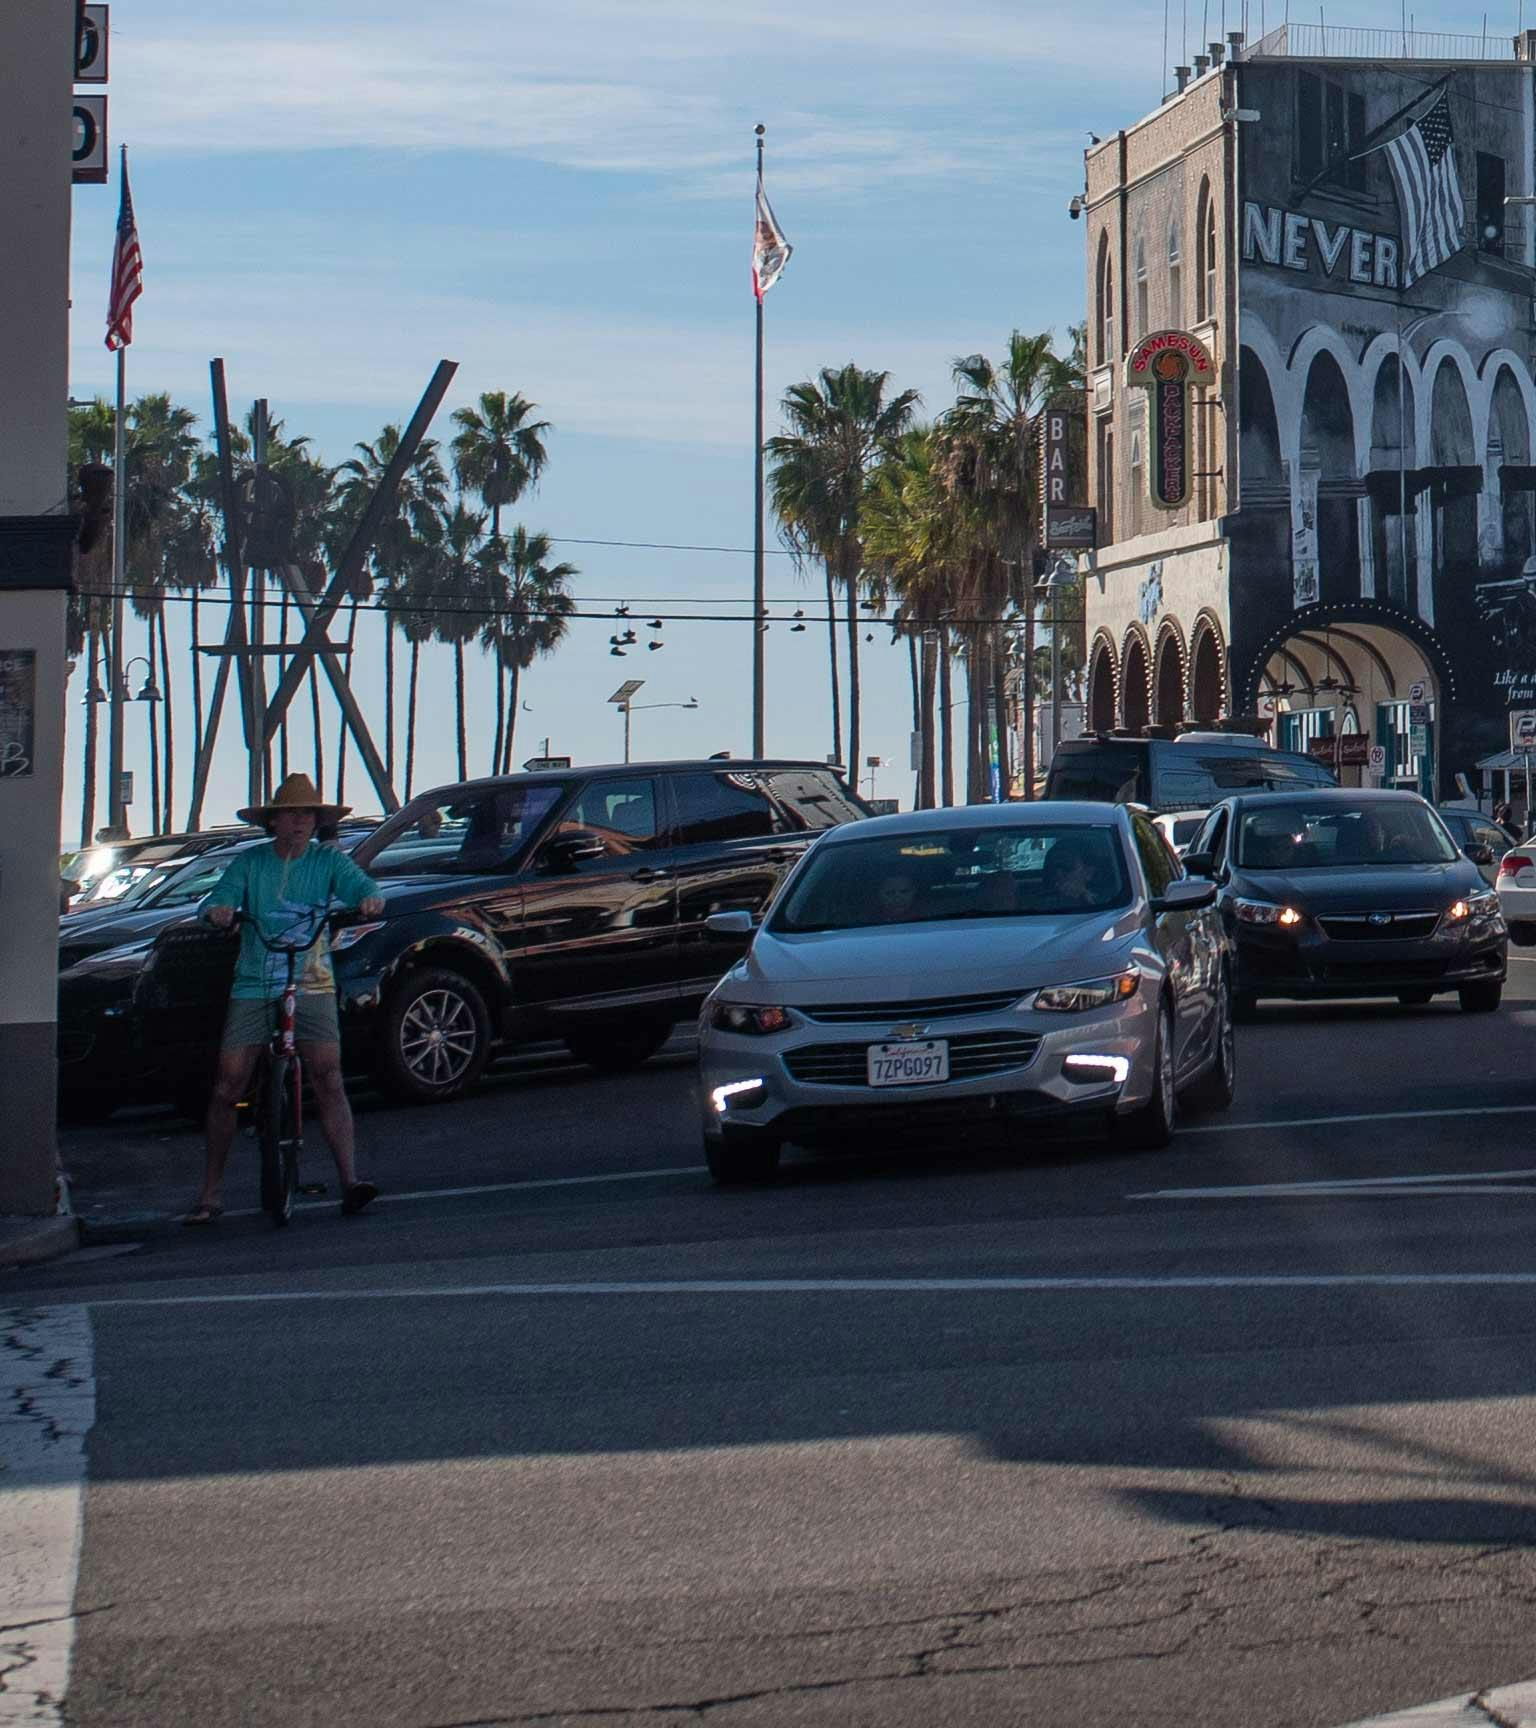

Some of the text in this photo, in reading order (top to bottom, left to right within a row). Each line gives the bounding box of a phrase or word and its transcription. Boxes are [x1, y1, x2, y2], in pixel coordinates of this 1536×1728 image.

[1243, 201, 1398, 288] NEVER
[1133, 334, 1209, 374] SAMESUN
[1050, 417, 1064, 502] BAR
[1493, 669, 1516, 685] Like
[1504, 687, 1533, 705] from
[873, 1056, 943, 1081] 7ZPG097
